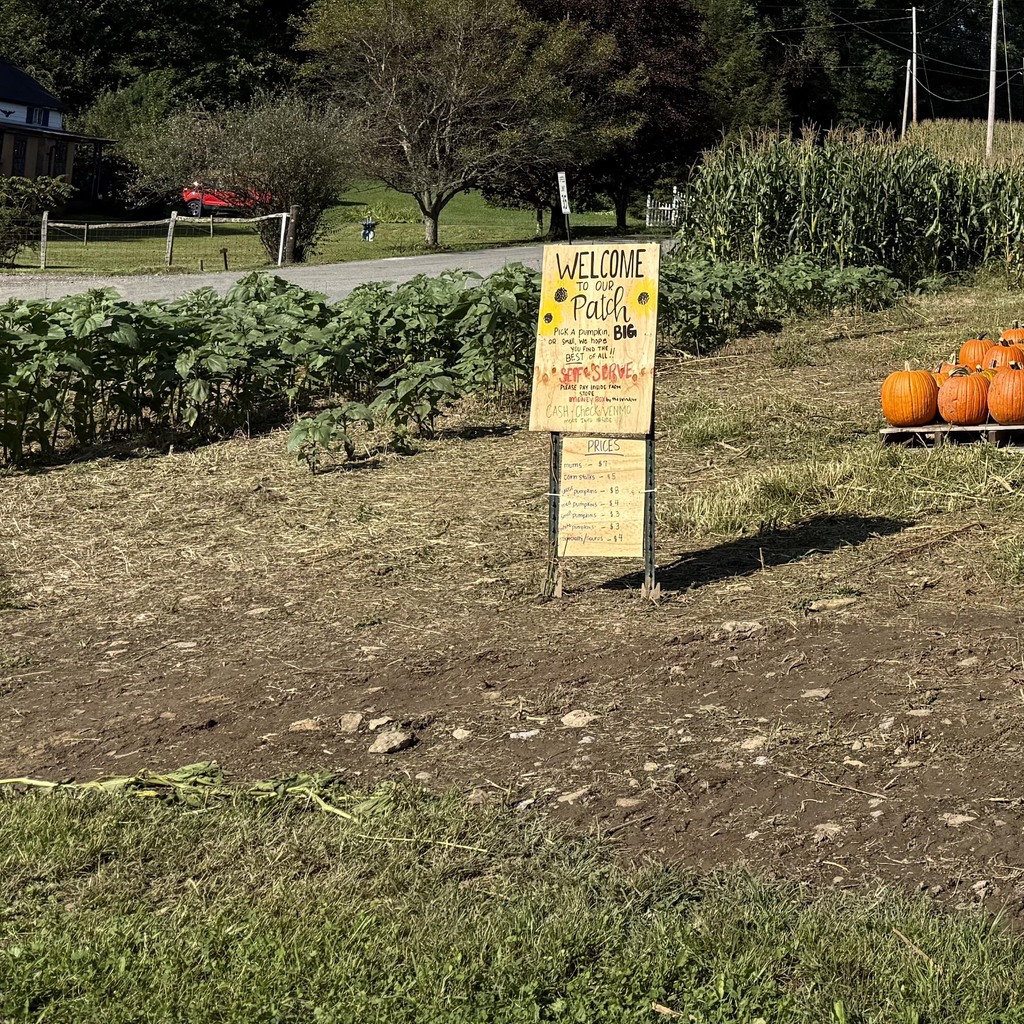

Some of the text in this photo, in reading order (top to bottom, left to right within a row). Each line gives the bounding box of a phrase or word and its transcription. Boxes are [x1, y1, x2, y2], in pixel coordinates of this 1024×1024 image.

[556, 249, 646, 279] WELCOME
[576, 281, 614, 291] TO OUR
[571, 286, 631, 322] Patch
[614, 324, 637, 340] BIG
[566, 353, 584, 362] BEST
[591, 362, 633, 382] SERVE
[546, 405, 567, 418] CASH
[603, 405, 632, 417] VENMO
[588, 439, 620, 452] PRICES
